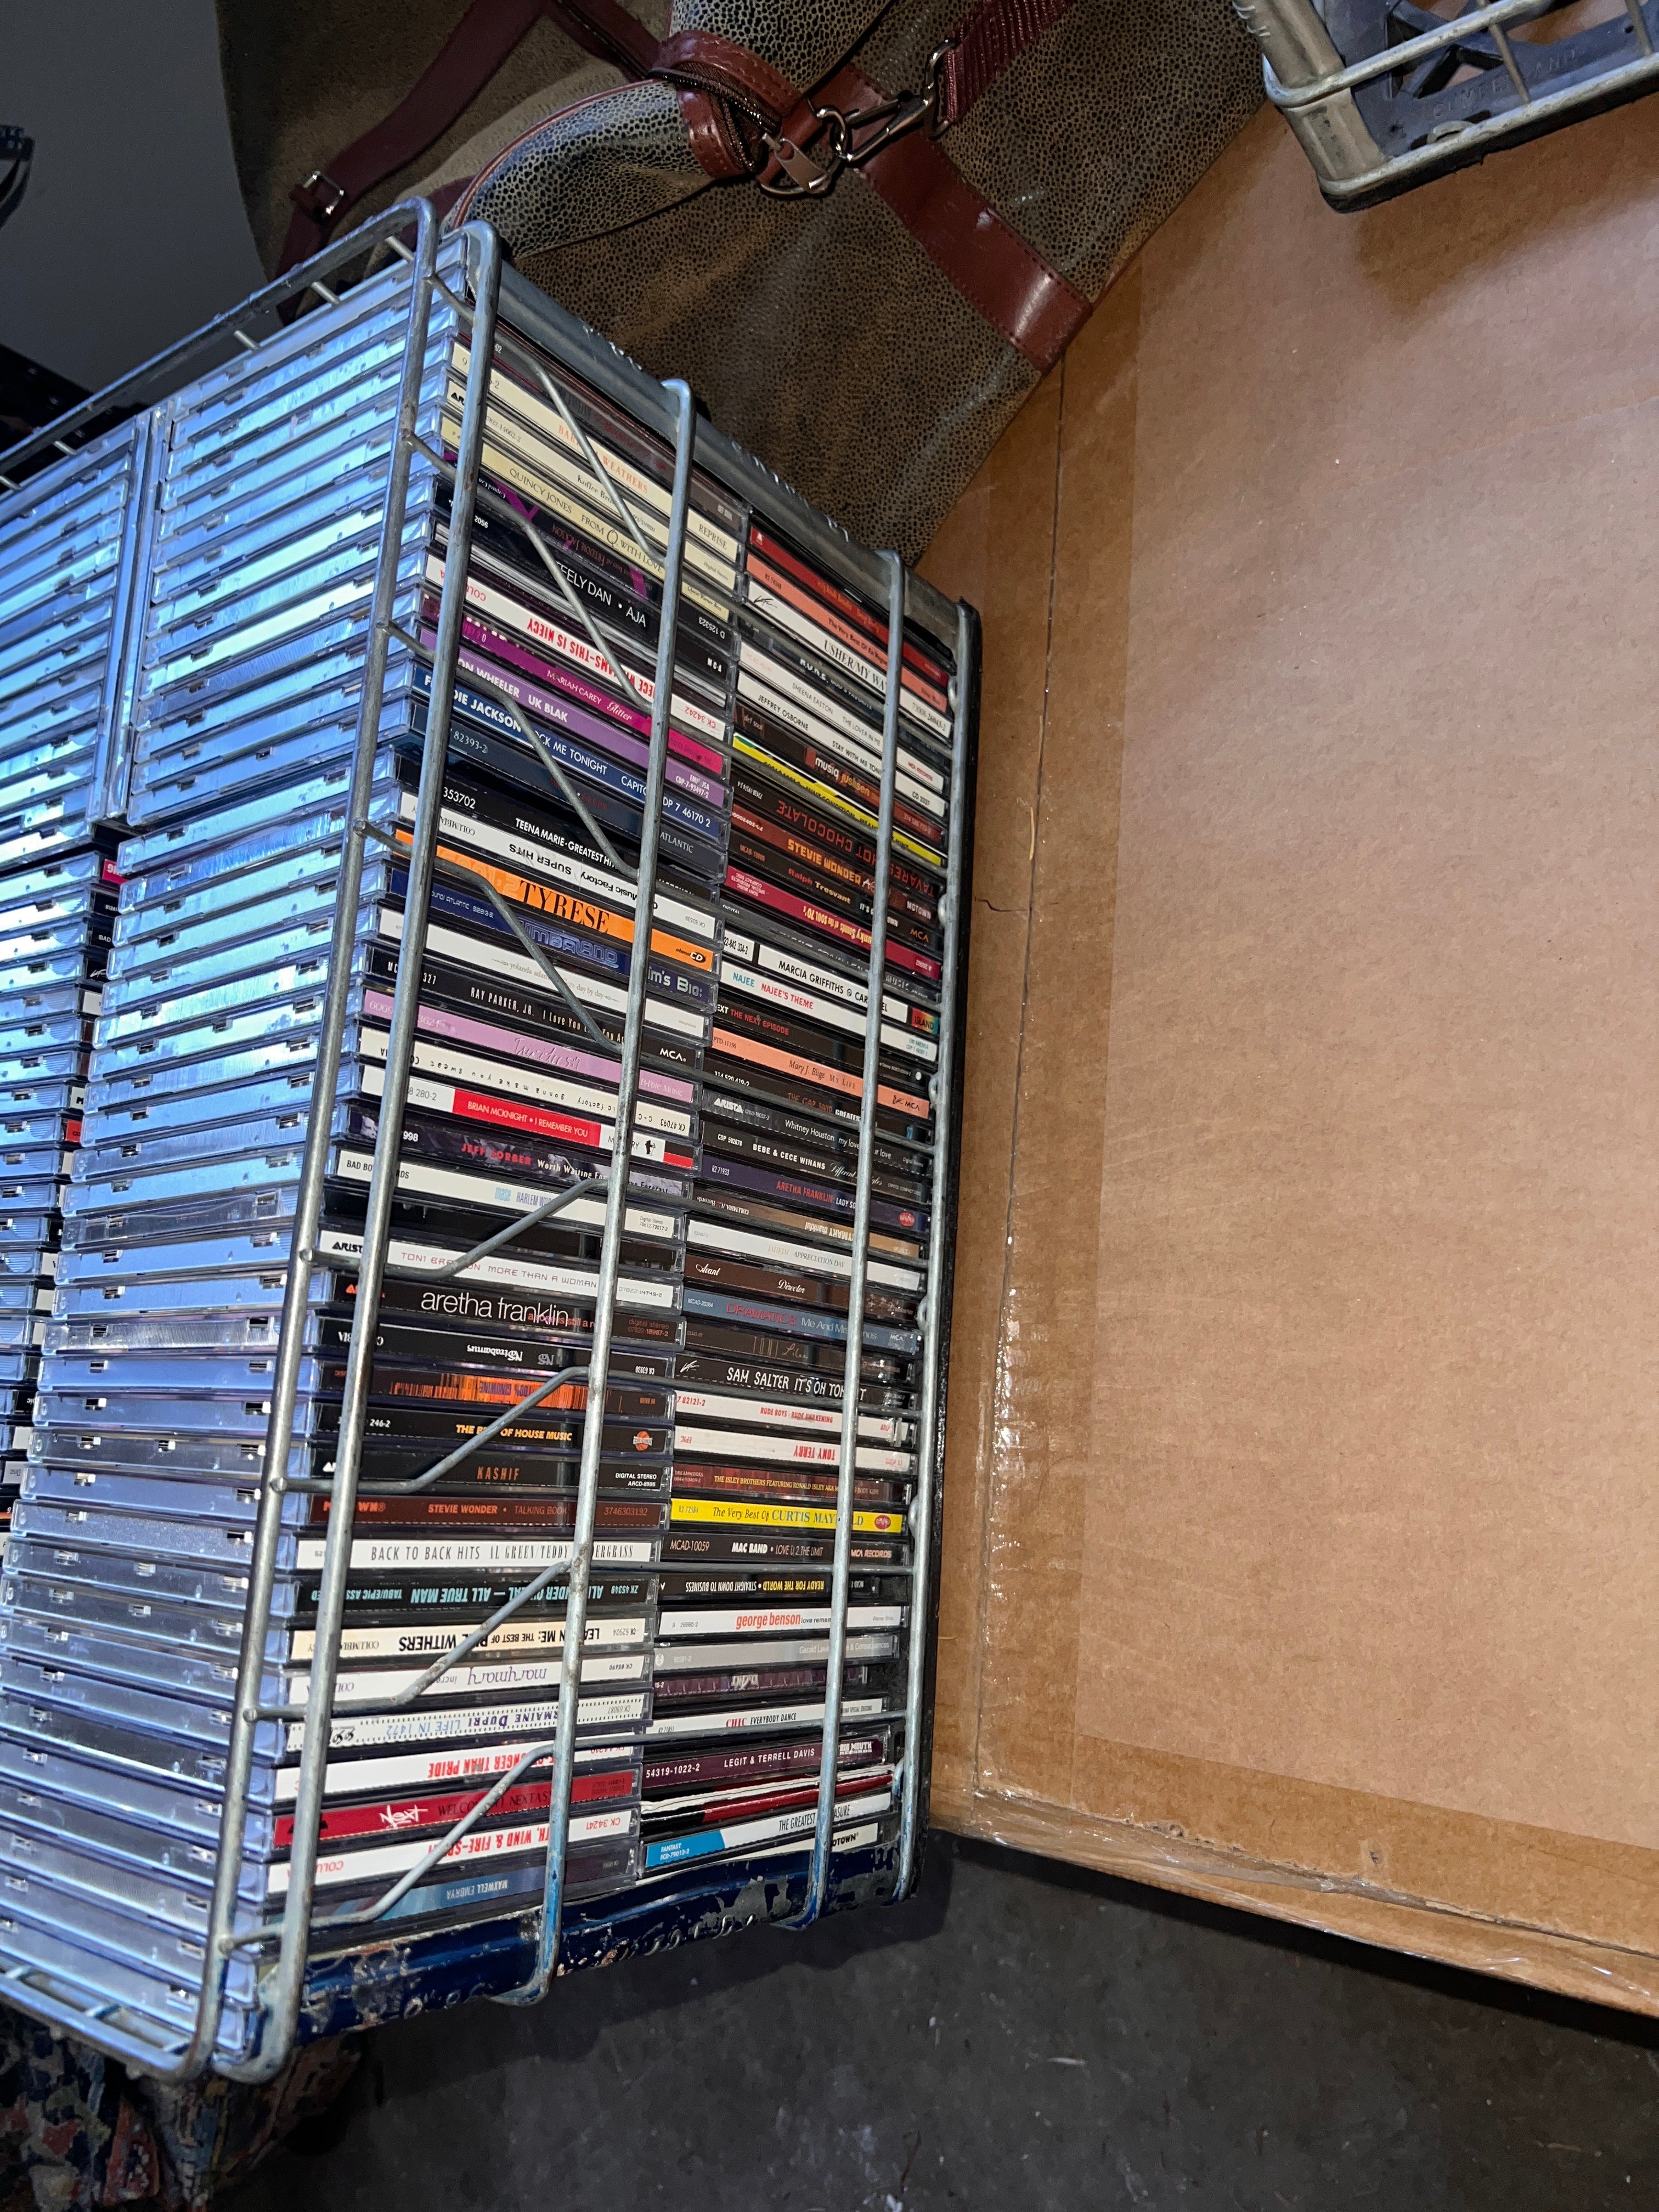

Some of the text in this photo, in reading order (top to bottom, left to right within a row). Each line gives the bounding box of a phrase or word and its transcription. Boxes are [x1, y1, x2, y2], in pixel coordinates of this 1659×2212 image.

[603, 459, 648, 494] WEATHERS
[510, 469, 662, 573] QUINCY JONES FROM WITH LOVE
[698, 524, 727, 550] REPRISE
[589, 584, 646, 628] DAN AJA
[528, 618, 554, 641] NIECY
[825, 640, 871, 676] USHER/MY
[477, 665, 568, 721] WHEELER UK BLAK
[547, 670, 632, 720] MARIAH CAREY Glitter
[793, 683, 834, 714] SHEENA EASTON
[758, 695, 846, 752] JEFFREY OSBORNE STAY
[471, 698, 703, 824] JACKSON ME TONIGHT 46170
[815, 757, 839, 783] musiq
[454, 732, 693, 853] 82393-2 ATLANTIC
[443, 787, 603, 863] 353702 TEENA MARIE GREATEST
[776, 800, 853, 852] CHOCOLATE
[535, 853, 613, 891] Factory SUPER
[788, 839, 861, 884] STEVIE WONDER
[789, 868, 851, 904] Ralph Tresvant
[520, 880, 609, 933] TYRESE
[907, 902, 931, 919] MOTOWN
[778, 961, 843, 995] MARCIA GRIFFITHS
[471, 988, 519, 1011] RAY PARKER,
[733, 973, 814, 1009] NAJEE NAJEE'S THEME
[730, 1009, 789, 1035] THE NEXT EPISODE
[789, 1060, 825, 1080] Mary Blige
[430, 1061, 603, 1110] factory gonna make you sweat
[714, 1098, 743, 1113] ARISTA
[467, 1102, 588, 1137] BRIAN MCKNIGHT REMEMBER YOU
[661, 1119, 676, 1130] 47093
[785, 1120, 834, 1141] Whitney Houston
[461, 1143, 592, 1180] JEFF LORBER Worth Waiting
[753, 1144, 826, 1170] BEBE CECE WINANS
[777, 1181, 801, 1195] ARETHA
[804, 1222, 827, 1235] thankful
[793, 1251, 832, 1265] APPRECIATION
[401, 1252, 597, 1289] TONI MORE THAN WOMAN
[696, 1263, 721, 1276] Avant
[778, 1279, 805, 1293] Director
[420, 1292, 568, 1328] aretha franklin
[726, 1304, 833, 1330] DRAMATICS Me And
[727, 1368, 825, 1394] SAM SALTER IT'S ON
[682, 1396, 706, 1406] 82121-2
[456, 1424, 572, 1441] THE HOUSE MUSIC
[794, 1446, 835, 1460] TONY TERRY
[477, 1466, 520, 1480] KASHIF
[766, 1480, 792, 1488] FEATURING
[428, 1504, 567, 1515] STEVIE WONDER TALKING BOOK
[603, 1507, 647, 1516] 3746303192
[713, 1508, 811, 1522] The Very Best CURTIS
[371, 1545, 567, 1560] BACK TO BACK HITS GREEN/TEDDY
[670, 1540, 789, 1555] MCAD-10059 MAC BAND LOVE
[363, 1587, 492, 1603] ALL TRUE MAN TABU/EPIC
[685, 1580, 824, 1592] READY THE WORLD STRAIGHT DOWN BUSINESS
[736, 1613, 801, 1629] george benson
[399, 1630, 556, 1651] ME: THE BEST WITHERS
[467, 1666, 548, 1686] marymary
[608, 1706, 623, 1714] 69087
[750, 1713, 797, 1725] EVERYBODY DANCE
[386, 1715, 507, 1736] DUPRI LIFE 1472
[428, 1760, 460, 1778] PRIDE
[646, 1748, 815, 1778] 54319-1022-2 LEGIT TERRELL DAVIS
[780, 1813, 816, 1831] THE GREATEST
[507, 1830, 531, 1846] WIND
[661, 1843, 681, 1852] FANTASY
[832, 1833, 857, 1847] OTOWN
[447, 1880, 507, 1899] MAXWELL EMBRYA
